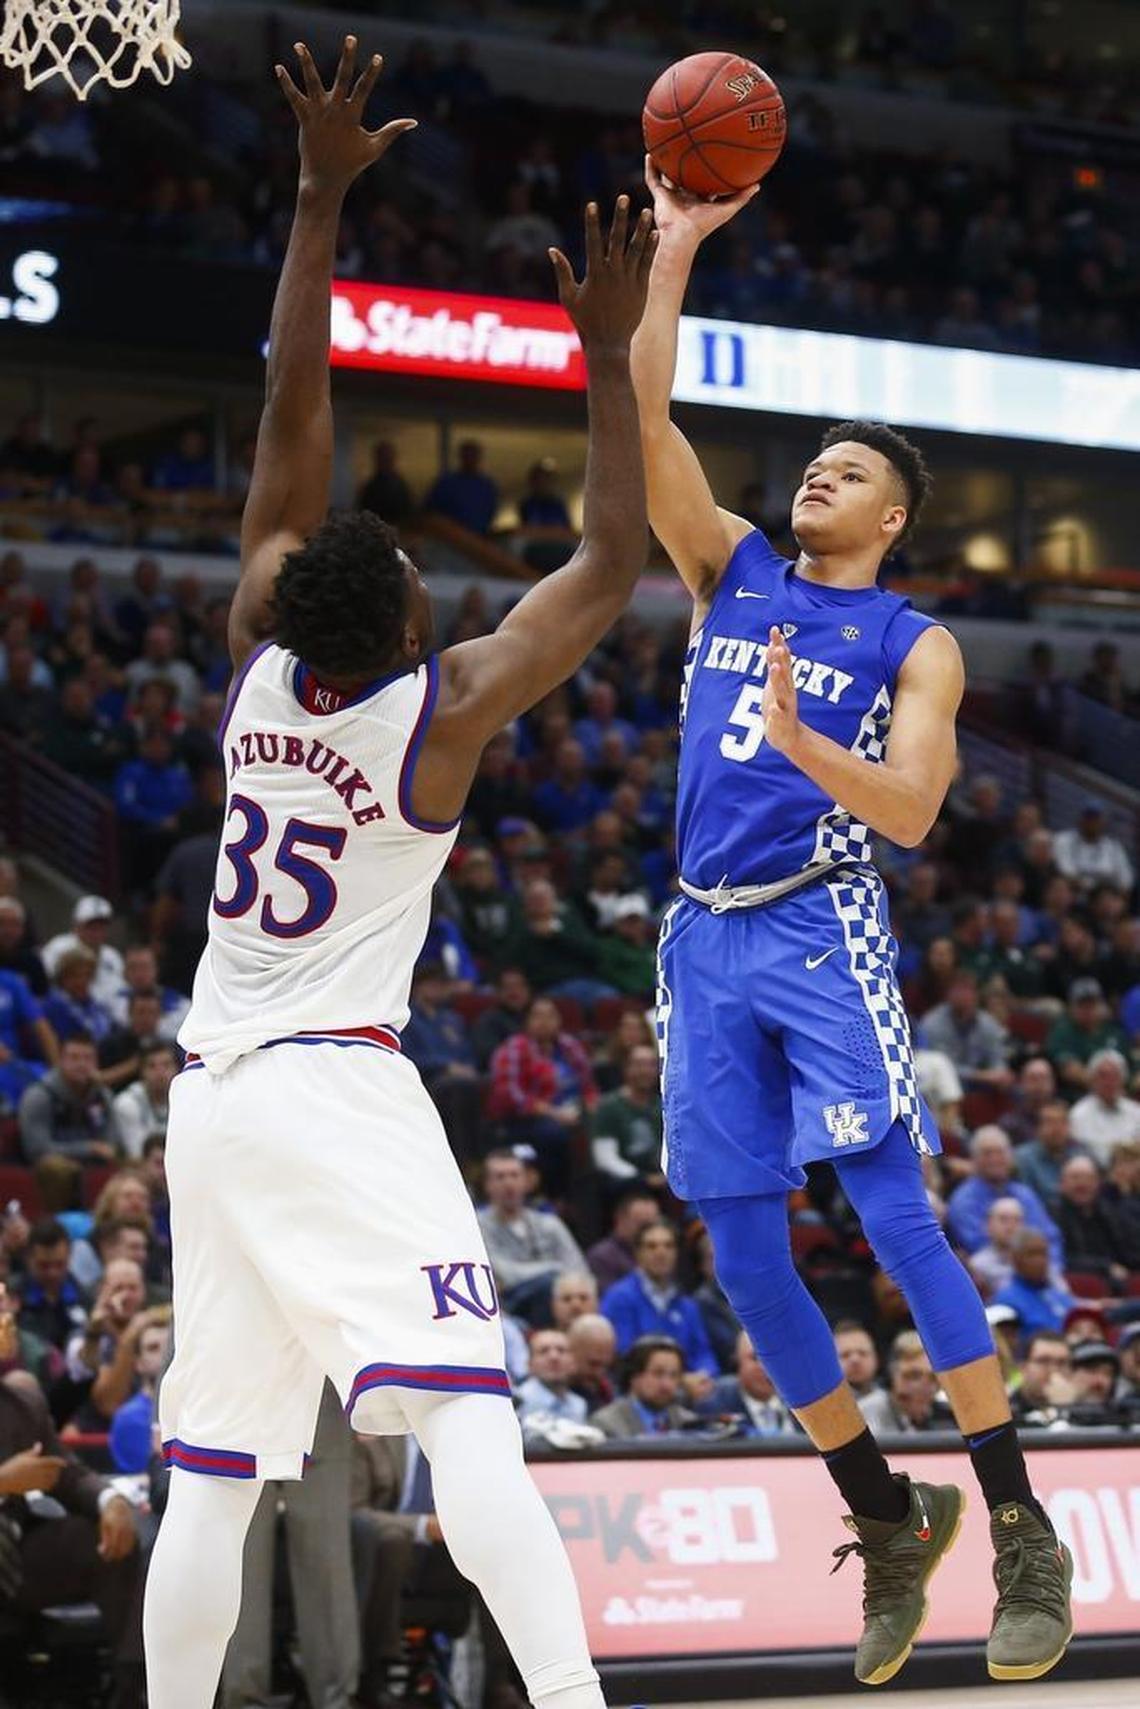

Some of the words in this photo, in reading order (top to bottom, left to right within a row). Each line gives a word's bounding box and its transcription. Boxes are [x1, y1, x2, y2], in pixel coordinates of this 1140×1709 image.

[314, 688, 340, 713] KU
[703, 635, 856, 705] KENTCKY
[719, 682, 765, 763] 5
[212, 793, 348, 939] 35
[420, 1262, 497, 1321] KU
